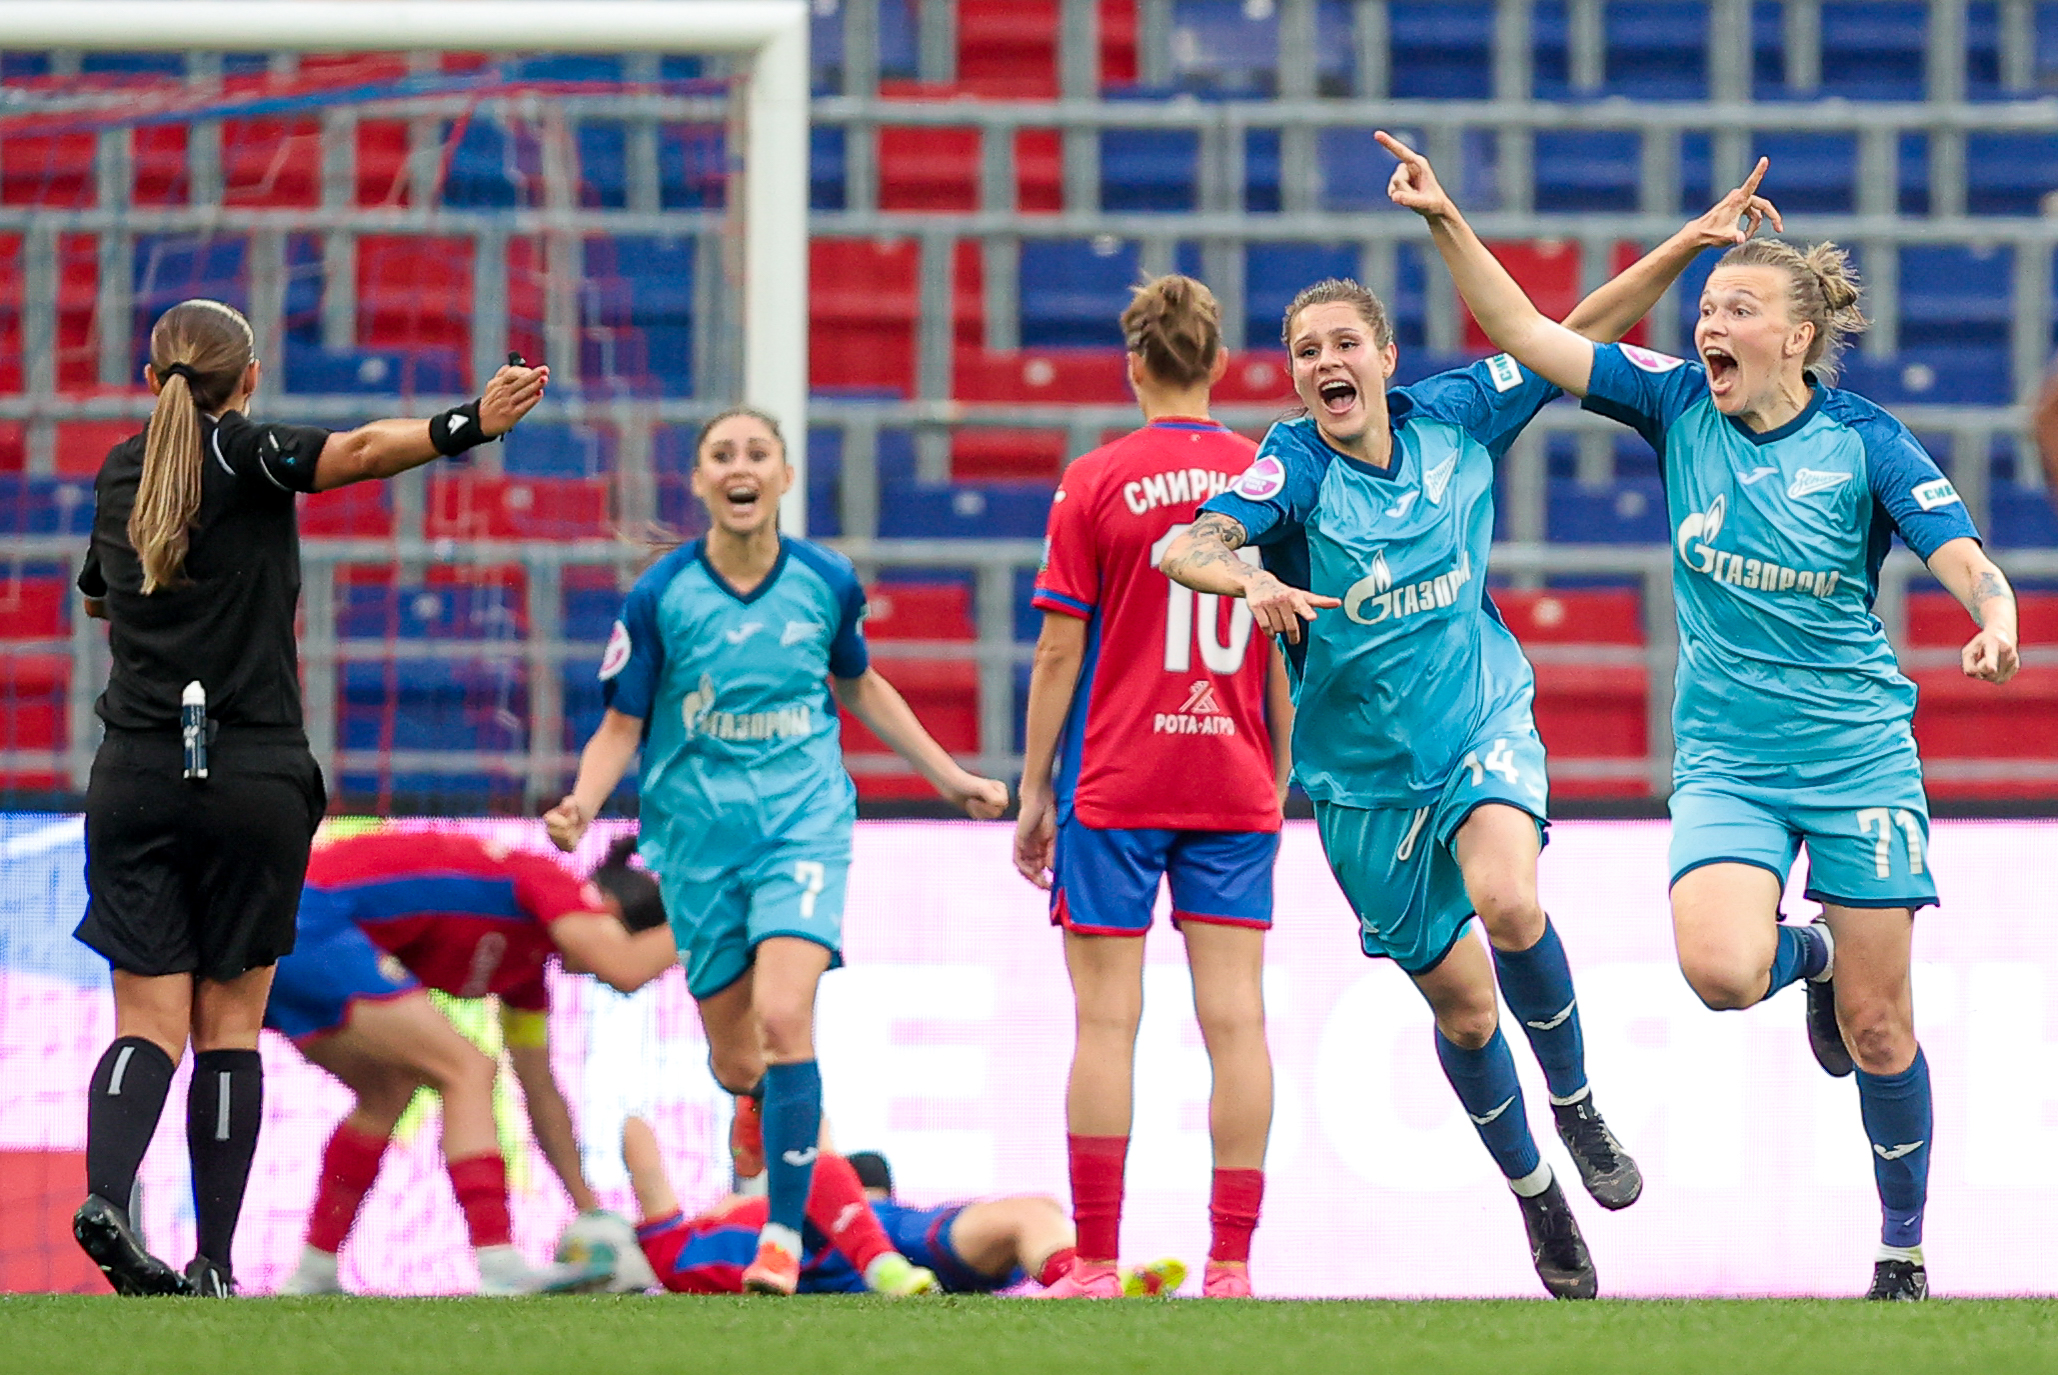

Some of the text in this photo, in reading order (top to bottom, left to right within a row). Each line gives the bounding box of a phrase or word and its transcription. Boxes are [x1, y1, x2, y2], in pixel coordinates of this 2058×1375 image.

[1150, 523, 1263, 674] 10
[1712, 549, 1840, 598] ГАЗПРОМ
[1462, 738, 1519, 788] 14
[1856, 806, 1924, 879] 71
[794, 860, 825, 919] 7
